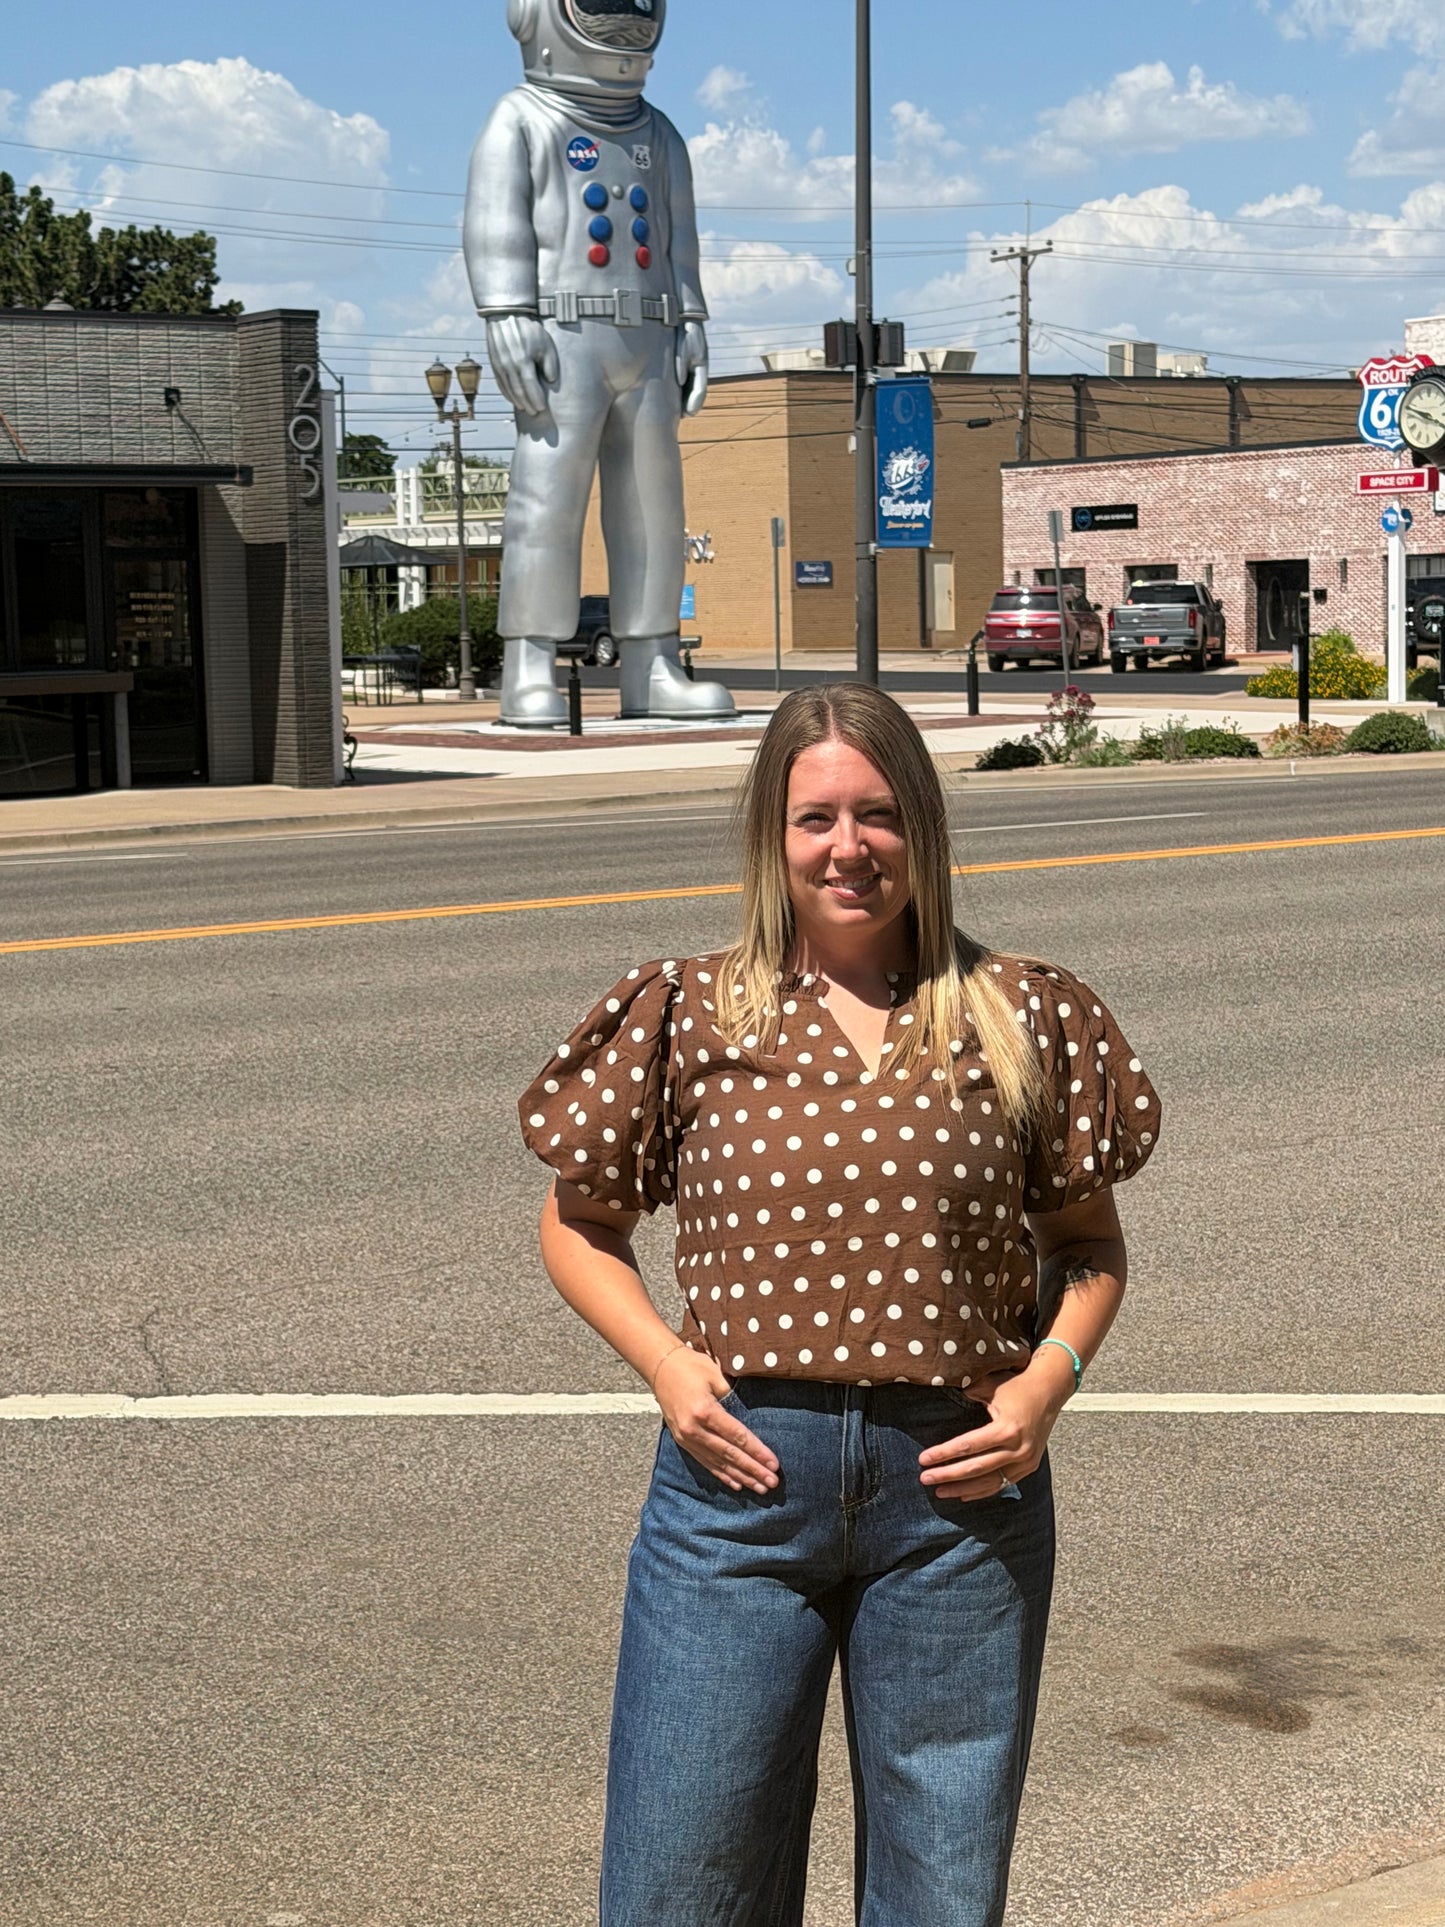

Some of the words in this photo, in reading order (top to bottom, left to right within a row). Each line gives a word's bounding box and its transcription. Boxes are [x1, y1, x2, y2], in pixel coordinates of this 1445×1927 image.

[568, 150, 598, 158] NASA
[636, 153, 649, 166] 66
[288, 363, 321, 498] 205
[1369, 476, 1395, 487] SPACE
[1396, 475, 1415, 486] CITY
